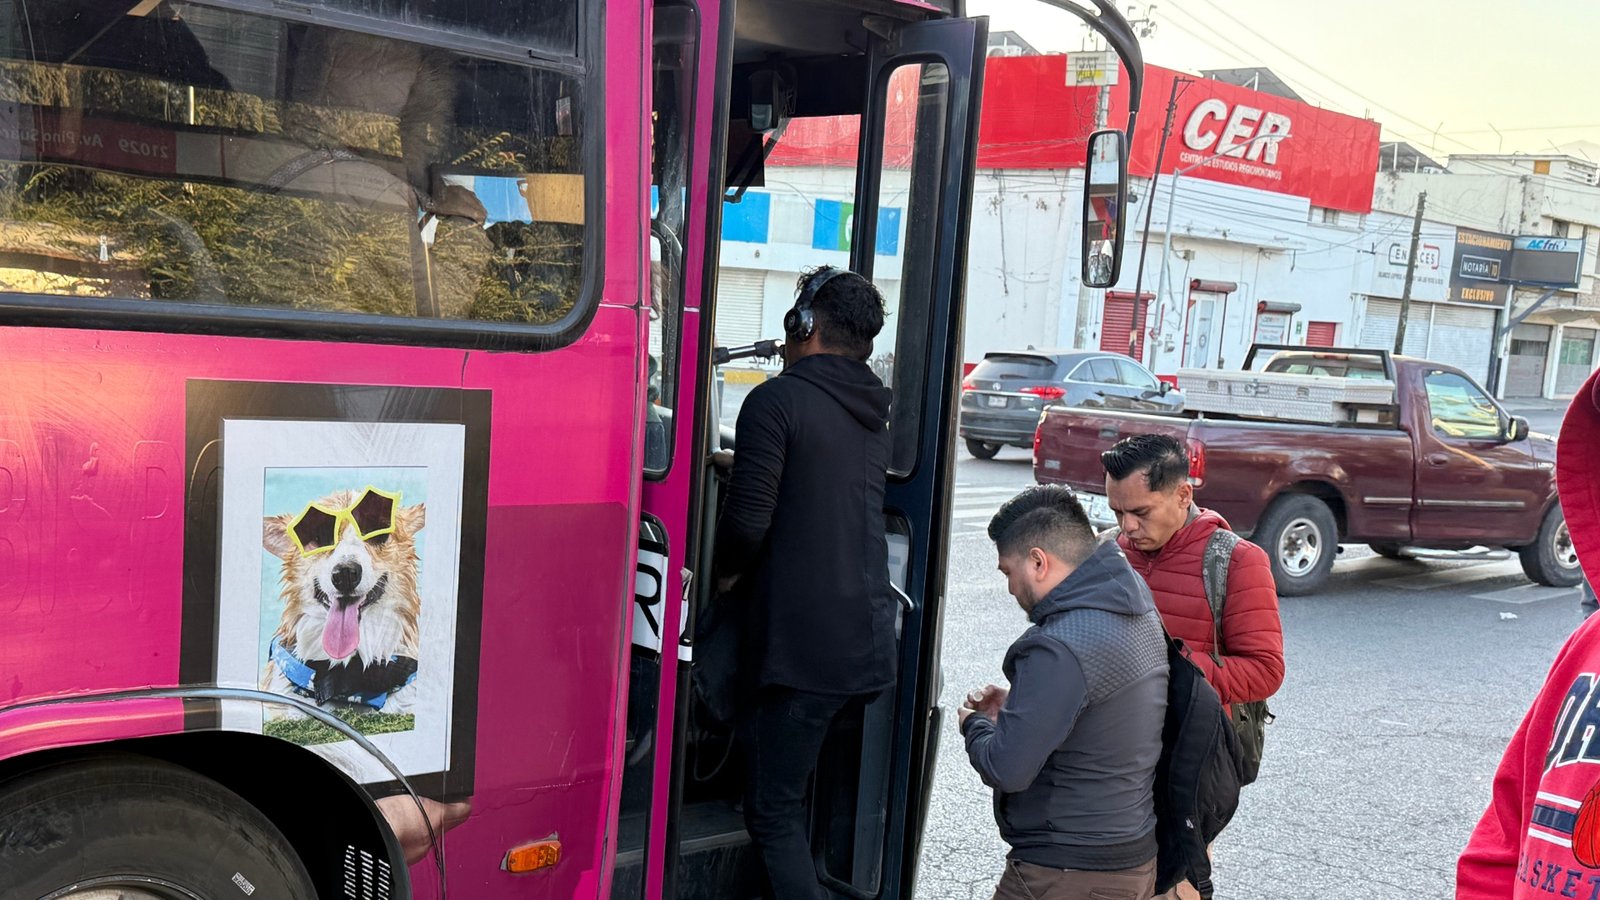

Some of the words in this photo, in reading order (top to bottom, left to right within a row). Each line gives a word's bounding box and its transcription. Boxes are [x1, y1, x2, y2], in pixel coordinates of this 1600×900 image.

[1183, 98, 1291, 165] CER
[1180, 152, 1203, 164] CENTRO
[1212, 158, 1238, 172] ESTUDIOS
[1457, 232, 1512, 251] ESTACIONAMIENTO
[1395, 248, 1435, 265] ENCES
[1461, 288, 1494, 302] EXCLUSIVO
